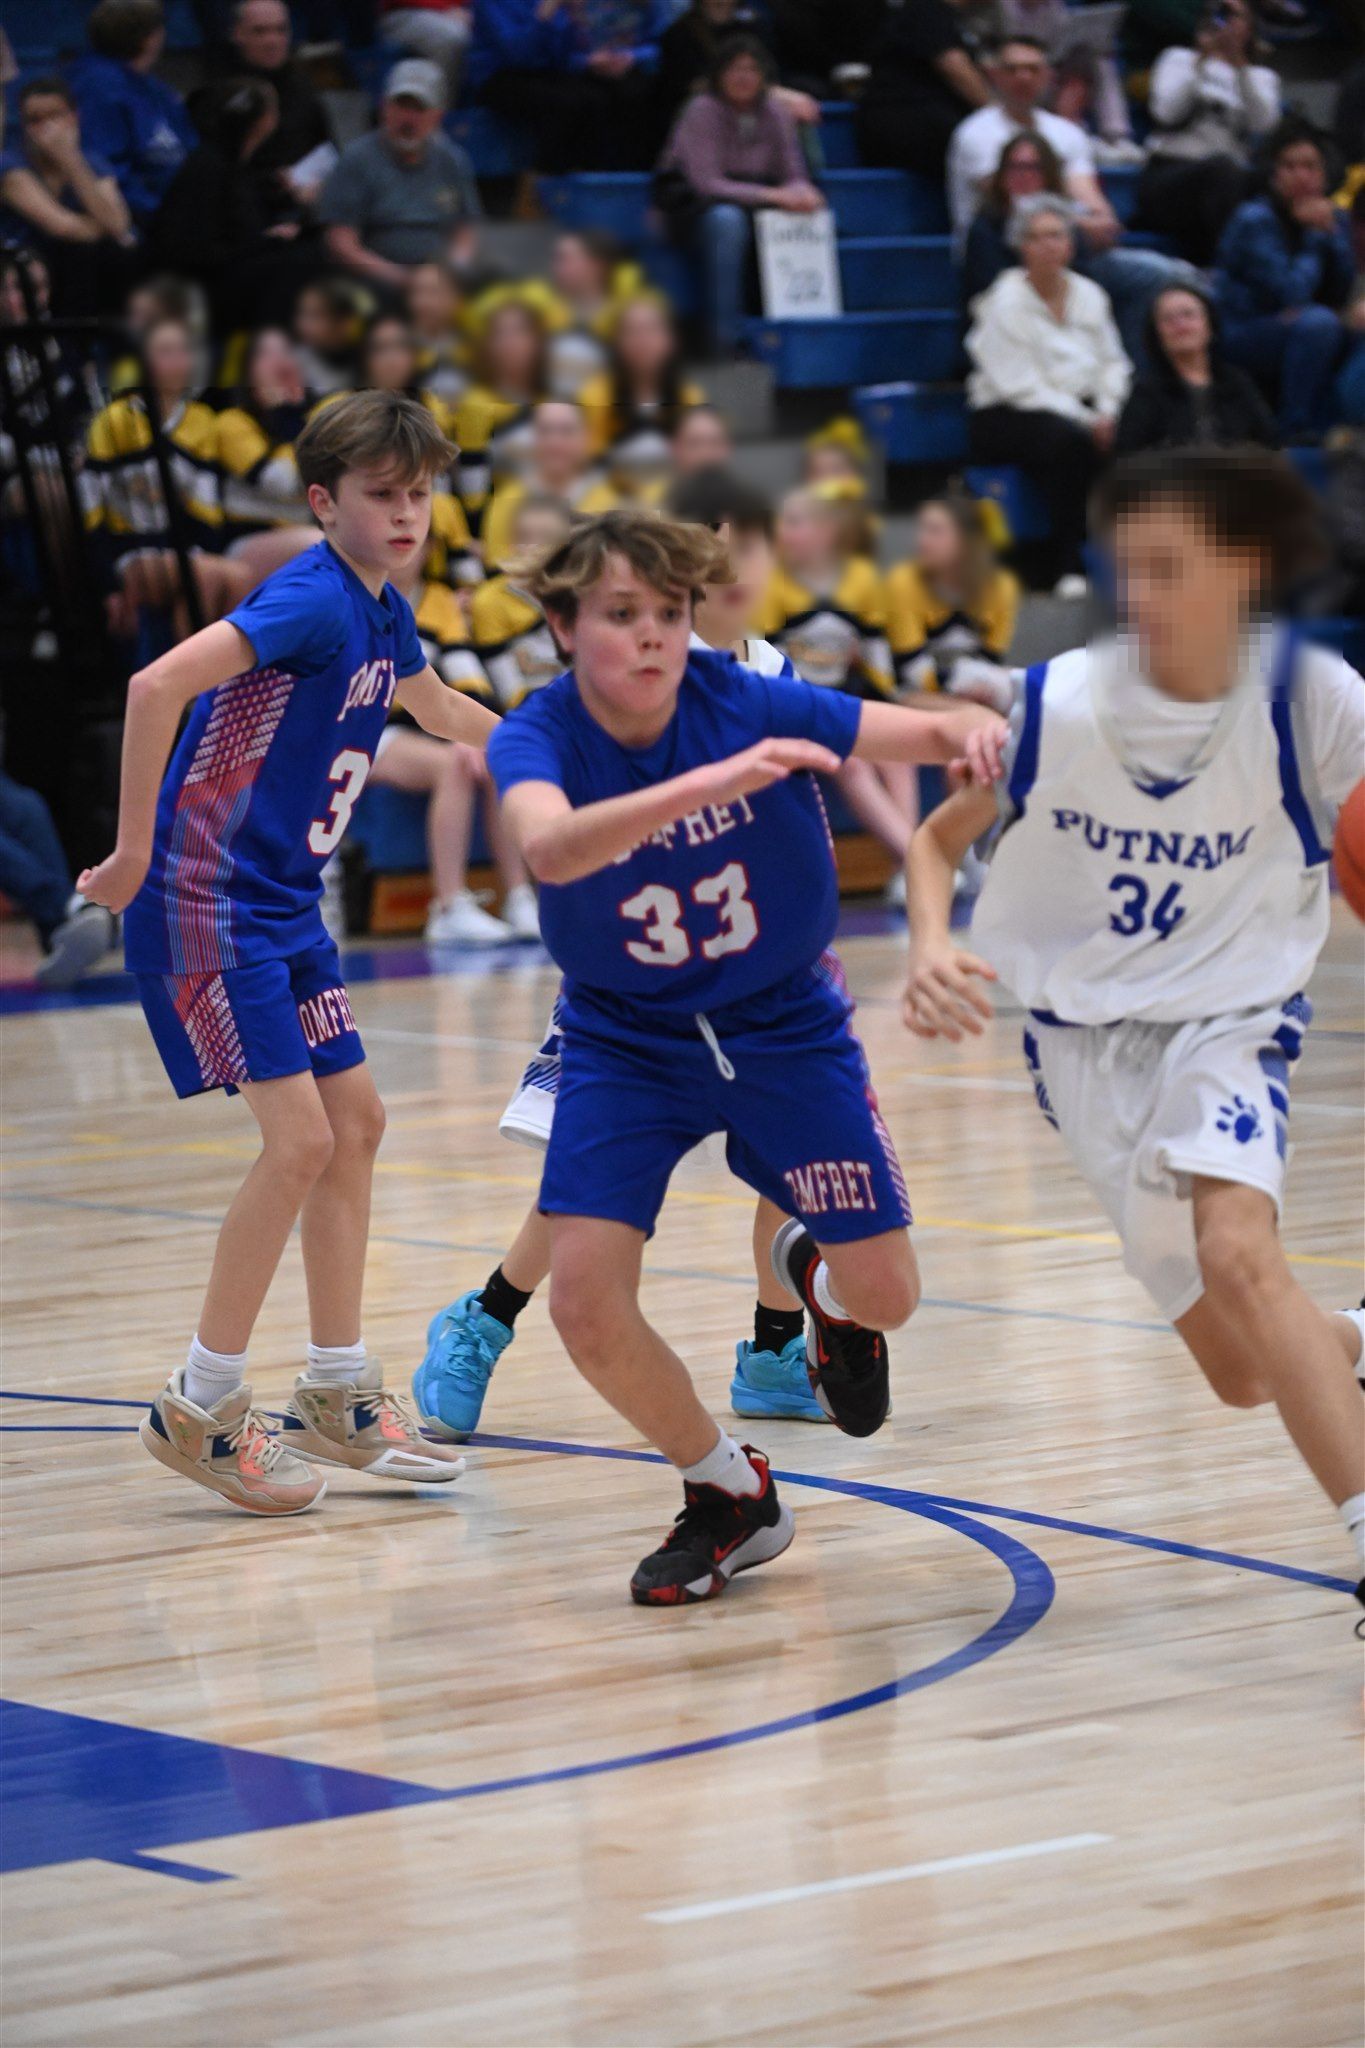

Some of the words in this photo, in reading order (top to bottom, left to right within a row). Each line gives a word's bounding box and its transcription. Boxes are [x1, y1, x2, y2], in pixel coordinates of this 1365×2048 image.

[307, 748, 371, 857] 3
[1052, 808, 1255, 870] PUTNAM
[620, 861, 759, 967] 33
[1109, 873, 1186, 941] 34
